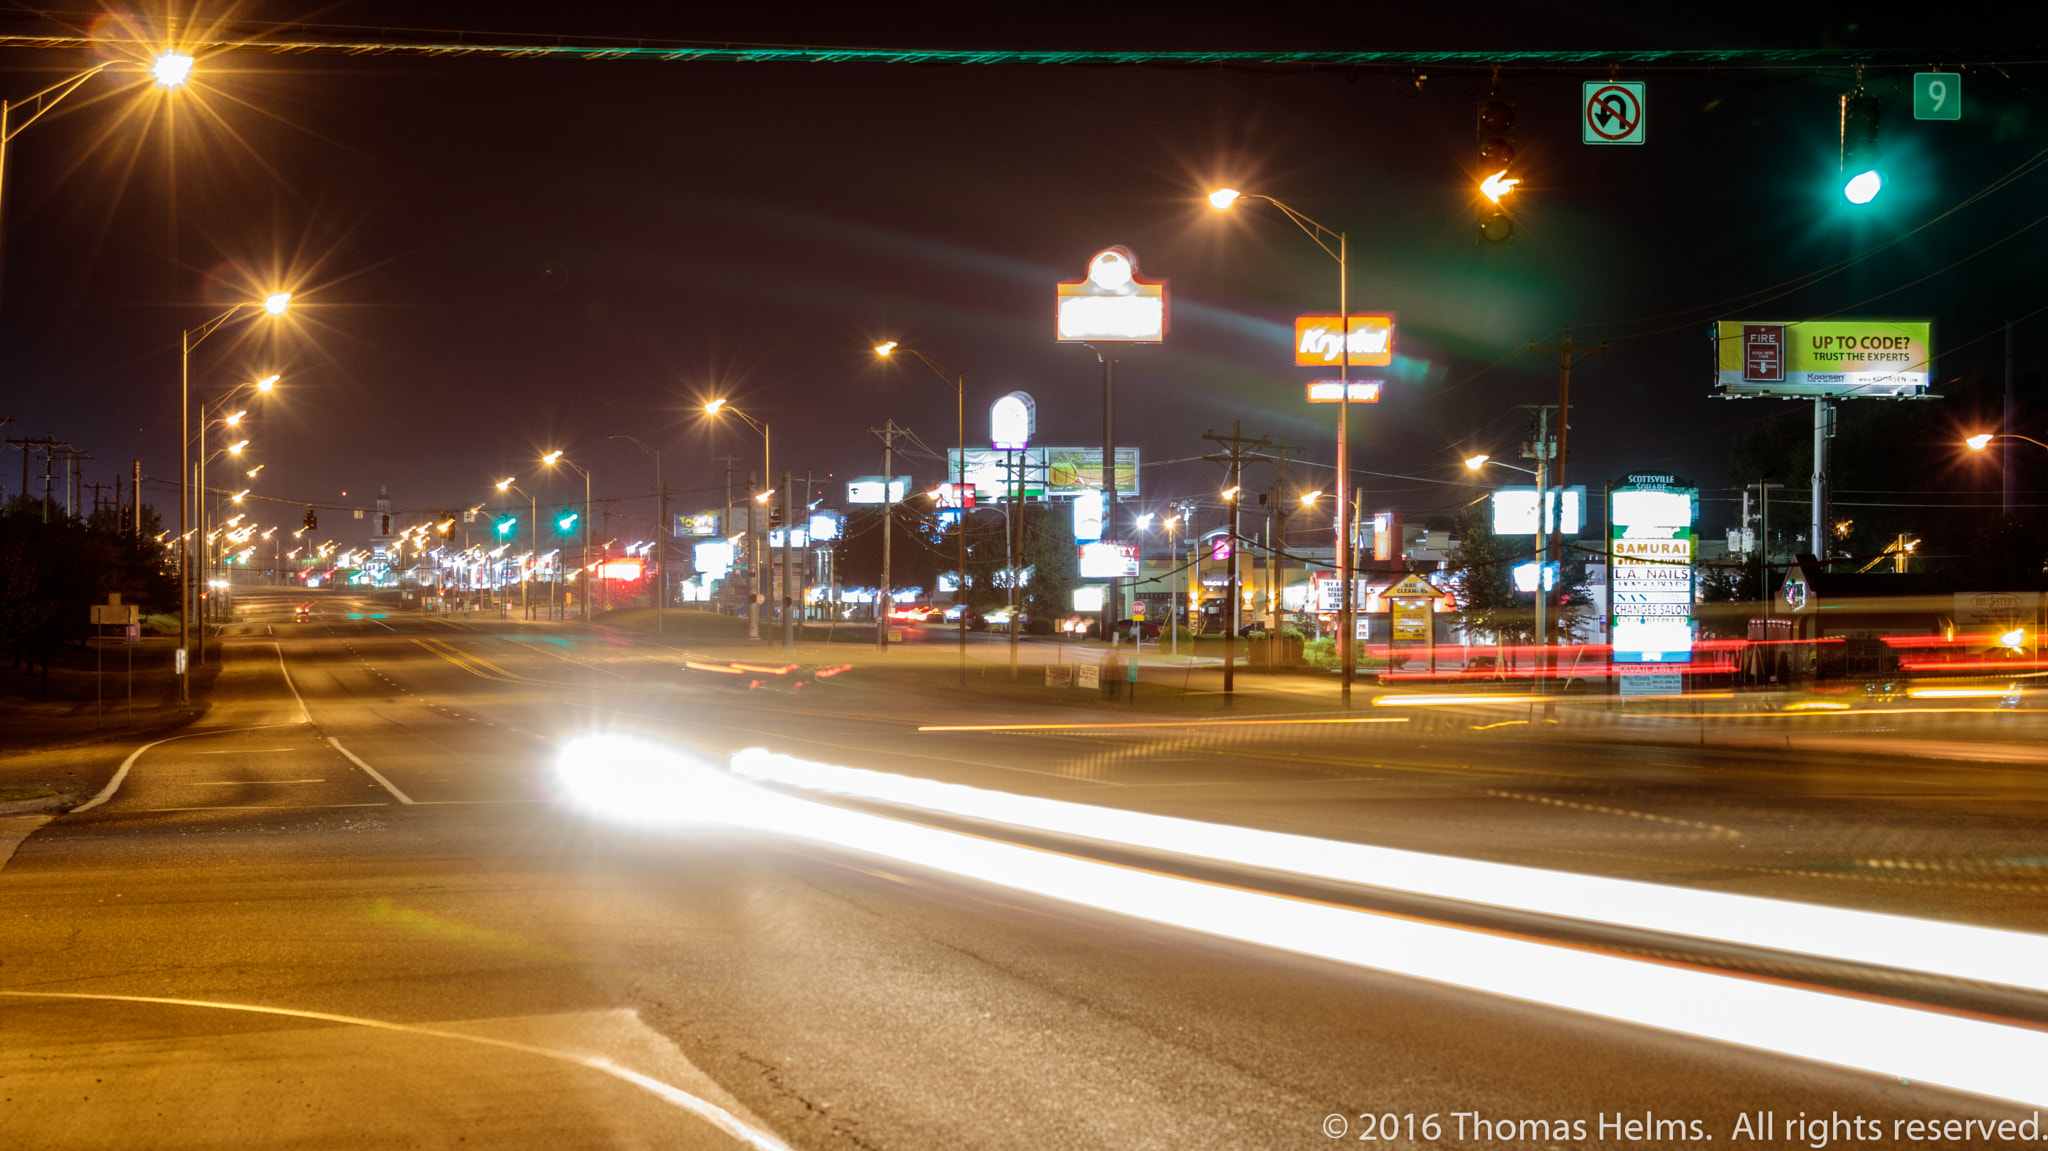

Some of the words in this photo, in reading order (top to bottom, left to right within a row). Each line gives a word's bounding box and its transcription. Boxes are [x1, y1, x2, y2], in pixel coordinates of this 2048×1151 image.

[1928, 80, 1946, 113] 9
[1750, 334, 1776, 343] FIRE
[1812, 336, 1833, 349] UP
[1836, 336, 1857, 349] TO
[1860, 336, 1910, 349] CODE?
[1299, 328, 1388, 361] Krytal
[1813, 352, 1844, 361] TRUST
[1846, 352, 1865, 361] THE
[1867, 352, 1910, 361] EXPERTS
[1628, 474, 1675, 484] SCOTTSVILLE
[1636, 483, 1667, 492] SQUARE
[1615, 543, 1687, 554] SAMURAI
[1614, 569, 1641, 579] L.A.
[1646, 569, 1689, 580] NAILS
[1614, 604, 1657, 615] CHANGES
[1660, 604, 1690, 615] SALON
[1621, 665, 1680, 674] AVAILABLE
